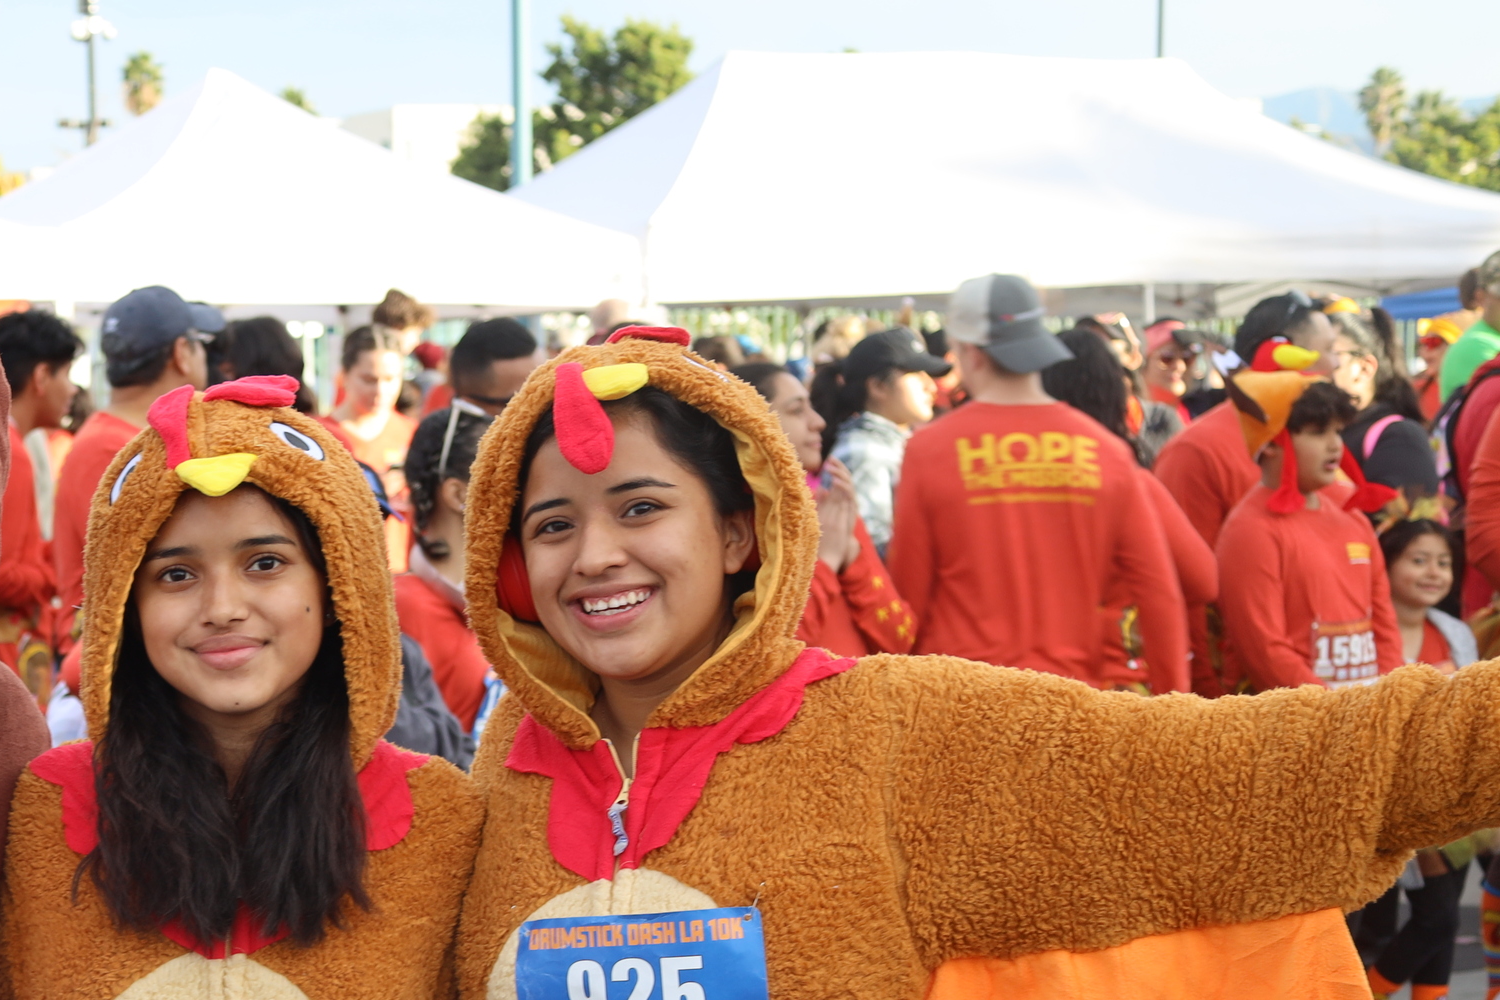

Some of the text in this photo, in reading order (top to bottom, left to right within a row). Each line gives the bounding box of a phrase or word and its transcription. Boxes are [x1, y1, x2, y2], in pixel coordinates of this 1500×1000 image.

[955, 431, 1101, 471] HOPE
[529, 916, 744, 950] DRUMSTICK DASH LA 10K
